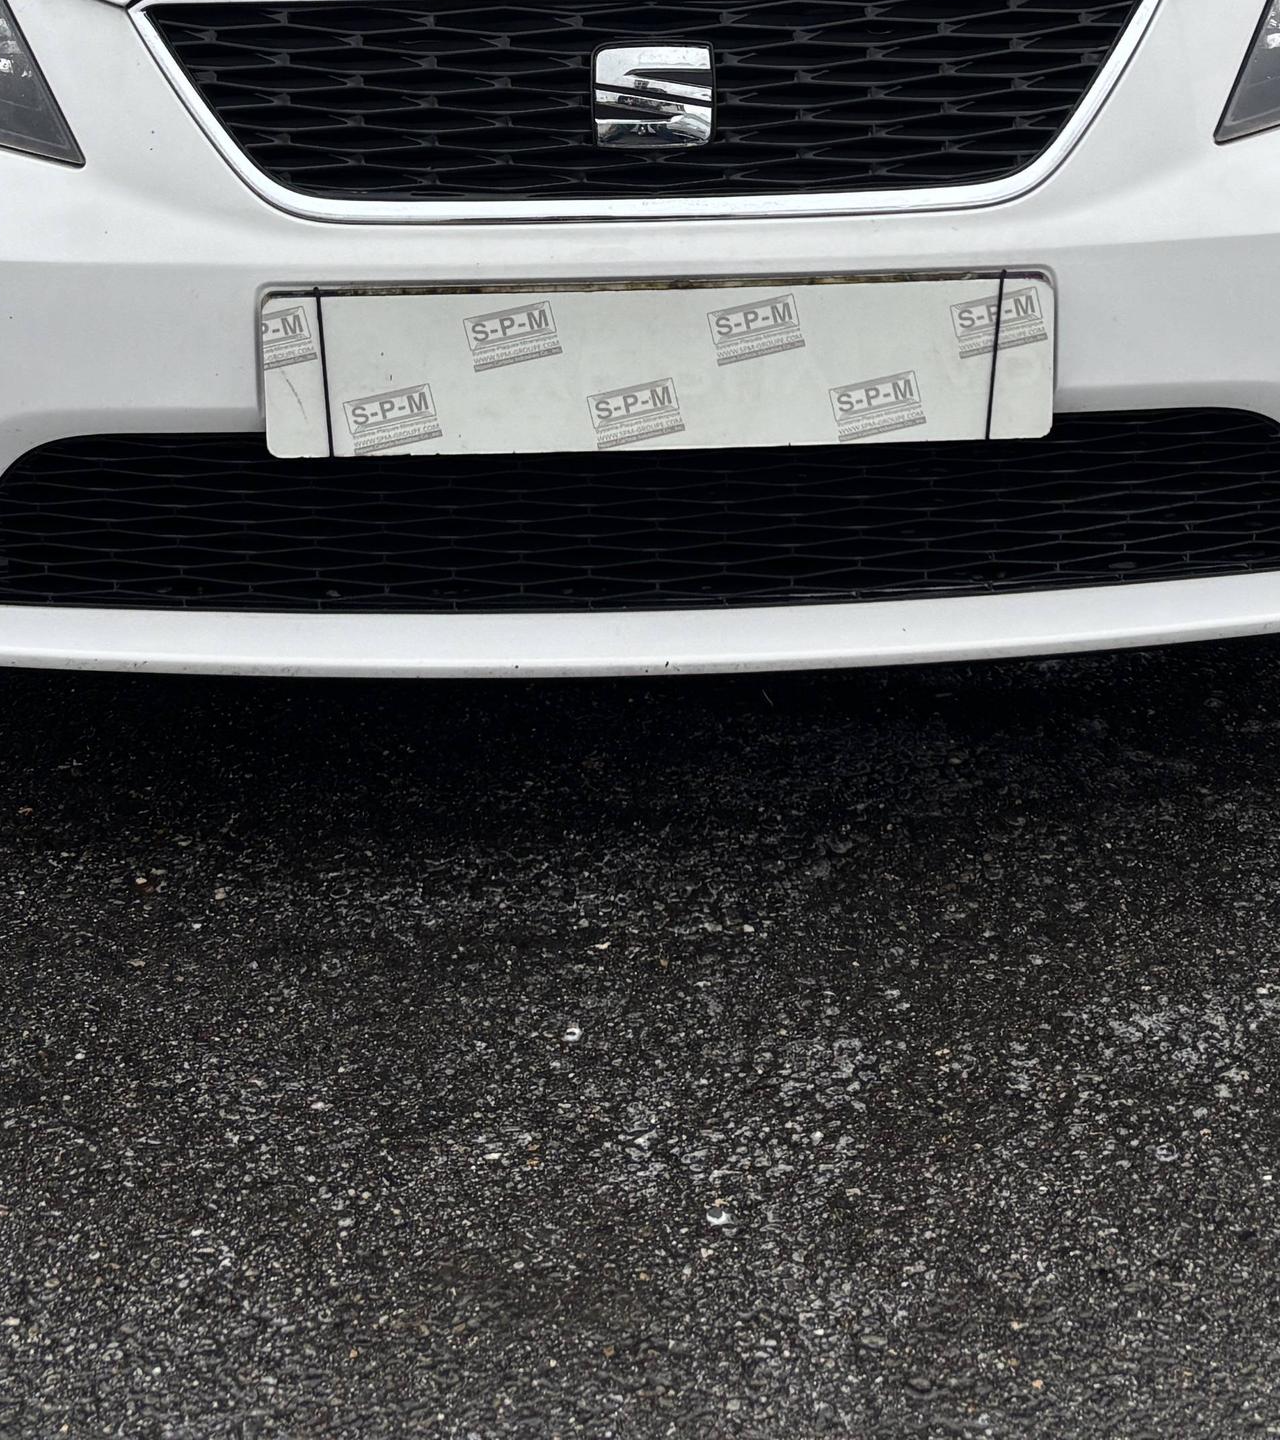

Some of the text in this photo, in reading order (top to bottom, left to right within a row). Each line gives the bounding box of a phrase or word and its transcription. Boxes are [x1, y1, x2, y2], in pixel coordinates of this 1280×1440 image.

[471, 309, 550, 342] S-P-M
[715, 302, 793, 336] S-P-M
[351, 391, 430, 425] S-P-M
[595, 386, 672, 420] S-P-M
[837, 378, 914, 412] S-P-M
